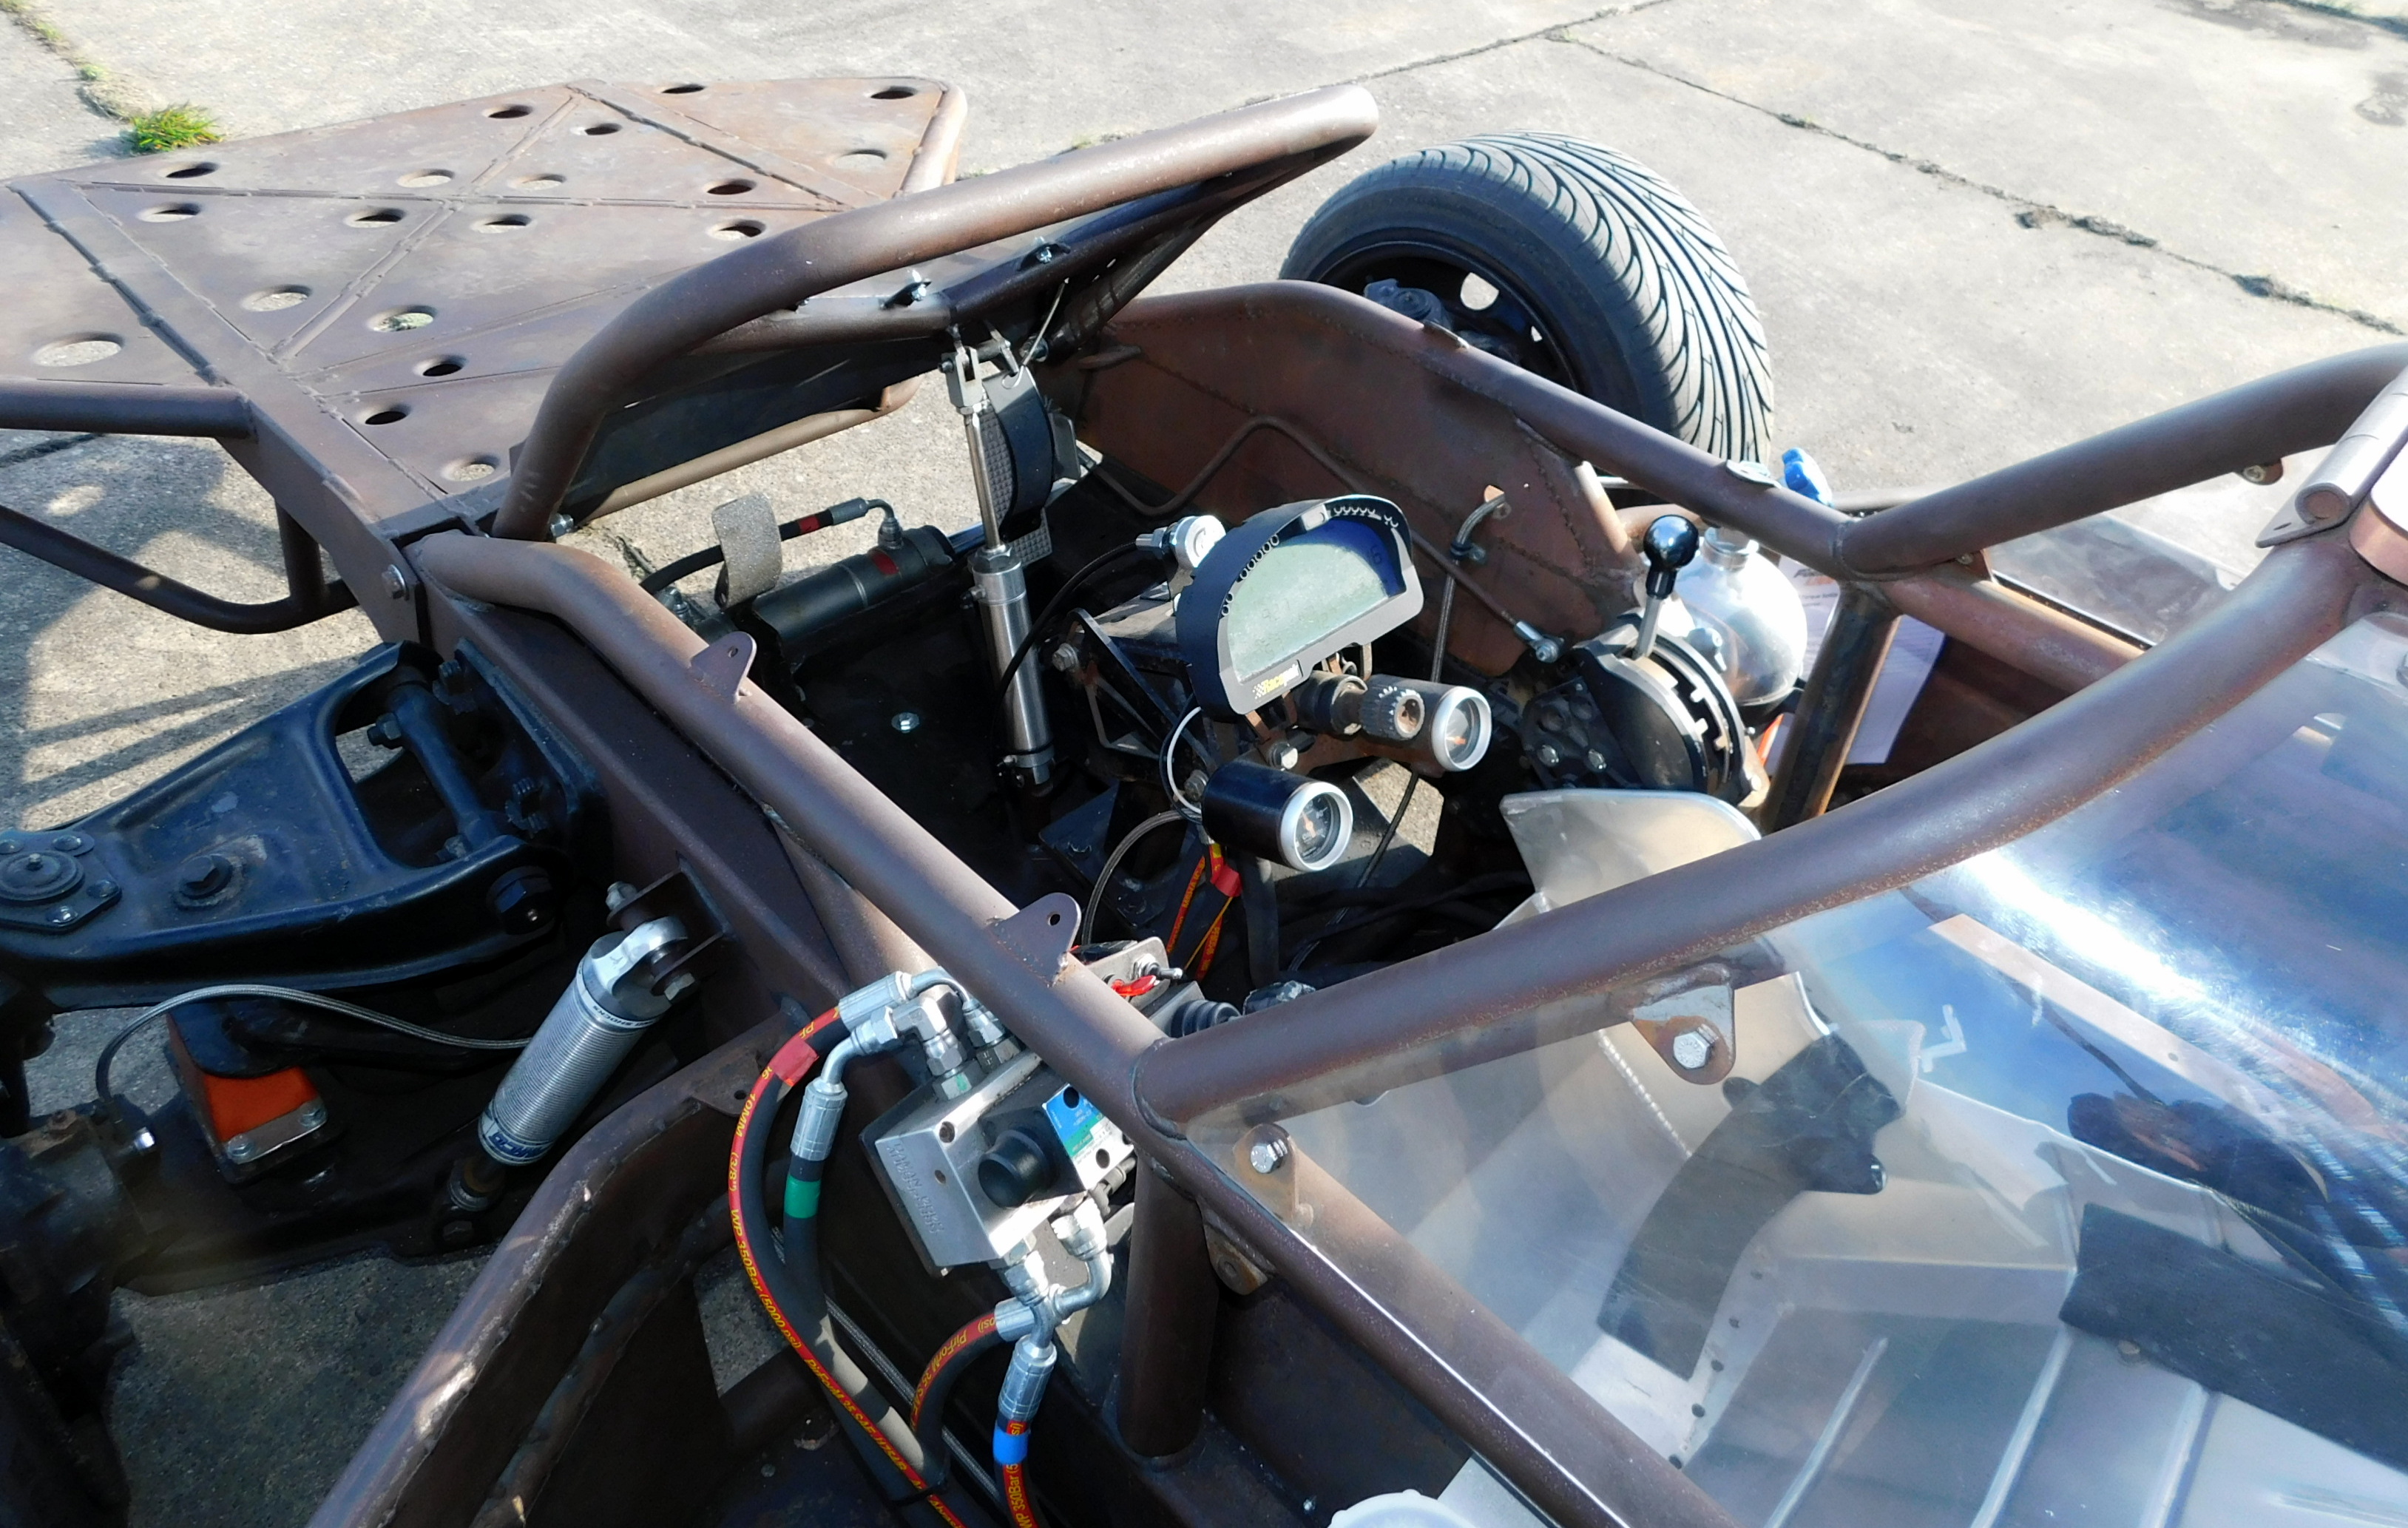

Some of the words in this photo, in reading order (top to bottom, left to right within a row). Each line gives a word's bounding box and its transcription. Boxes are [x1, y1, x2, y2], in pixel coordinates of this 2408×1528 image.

[735, 1093, 756, 1137] 10MM
[730, 1209, 744, 1237] WP
[737, 1240, 763, 1292] 350Bar
[759, 1293, 785, 1328] (5000
[782, 1330, 802, 1349] psi)
[931, 1329, 967, 1373] PirForM
[1009, 1475, 1027, 1512] 350Bar
